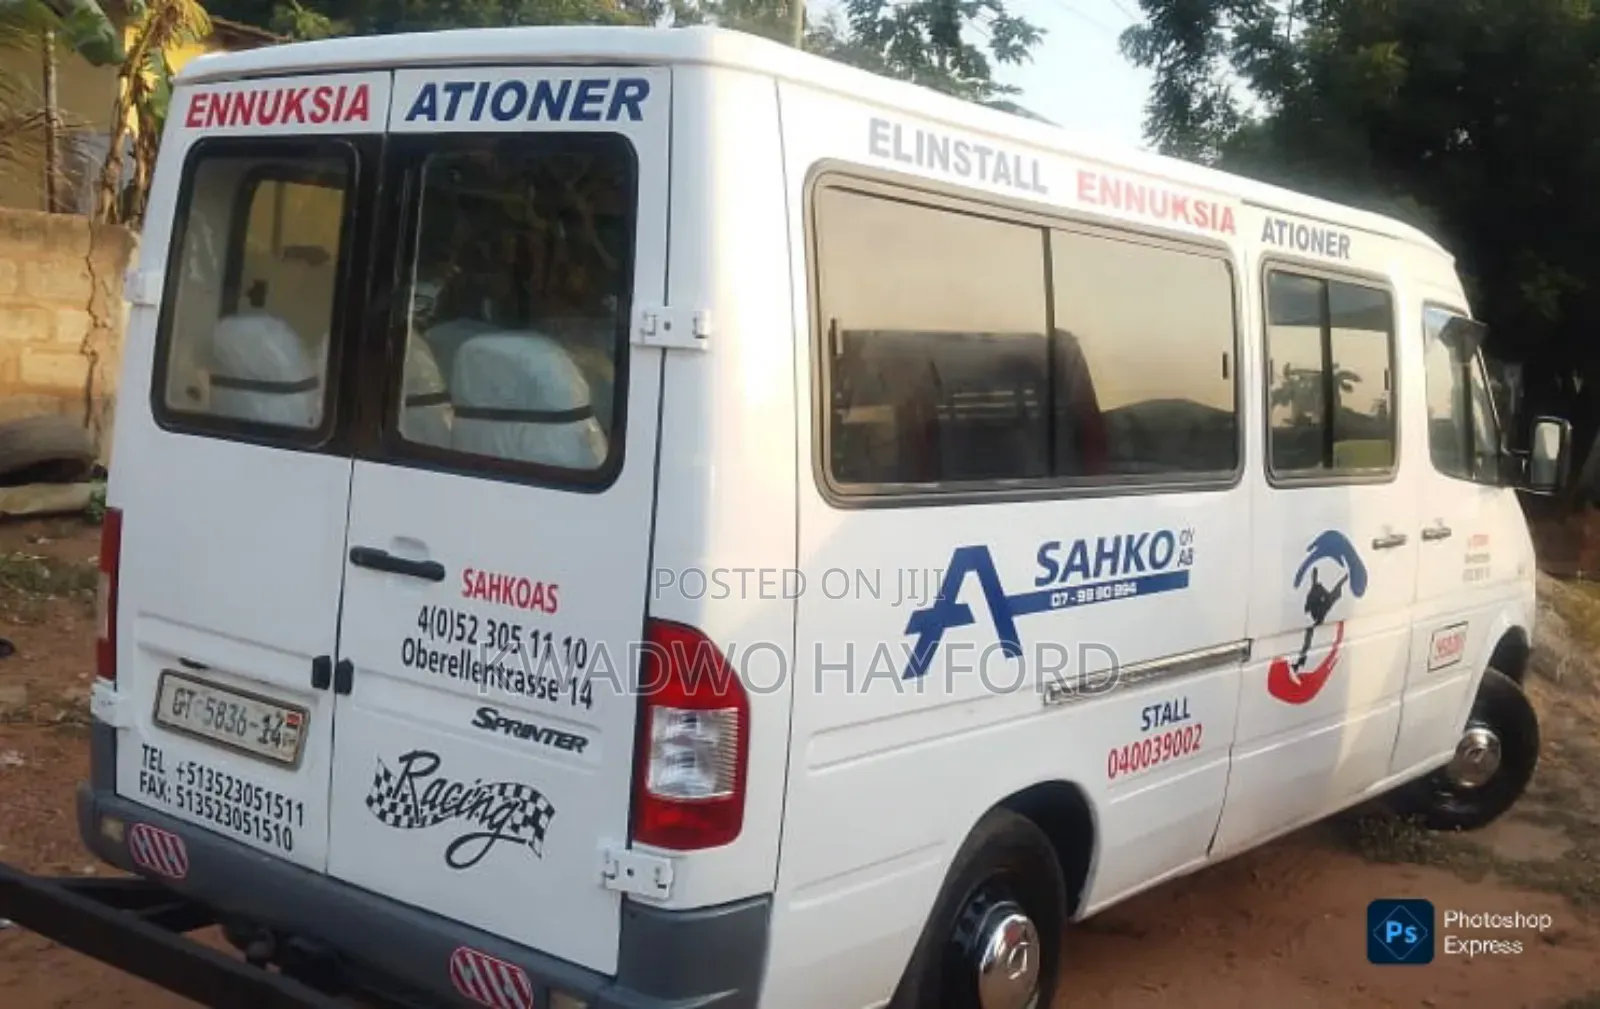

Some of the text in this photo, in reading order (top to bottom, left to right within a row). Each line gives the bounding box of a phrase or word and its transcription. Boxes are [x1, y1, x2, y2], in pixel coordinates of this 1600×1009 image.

[185, 84, 370, 128] ENNUKSIA
[405, 78, 650, 123] ATIONER
[868, 117, 1237, 235] ELINSTALL ENNUKSIA
[1261, 216, 1352, 260] ATIONER
[1034, 529, 1175, 586] SAHKO
[461, 568, 559, 614] SAHKOAS
[418, 605, 588, 669] 4(0)52 305 11 10
[568, 677, 593, 710] 14
[1140, 696, 1191, 731] STALL
[1107, 723, 1203, 779] 040039002
[139, 770, 293, 851] FAX: 513523051510
[142, 743, 304, 827] TEL +513523051511
[393, 750, 527, 869] Racing
